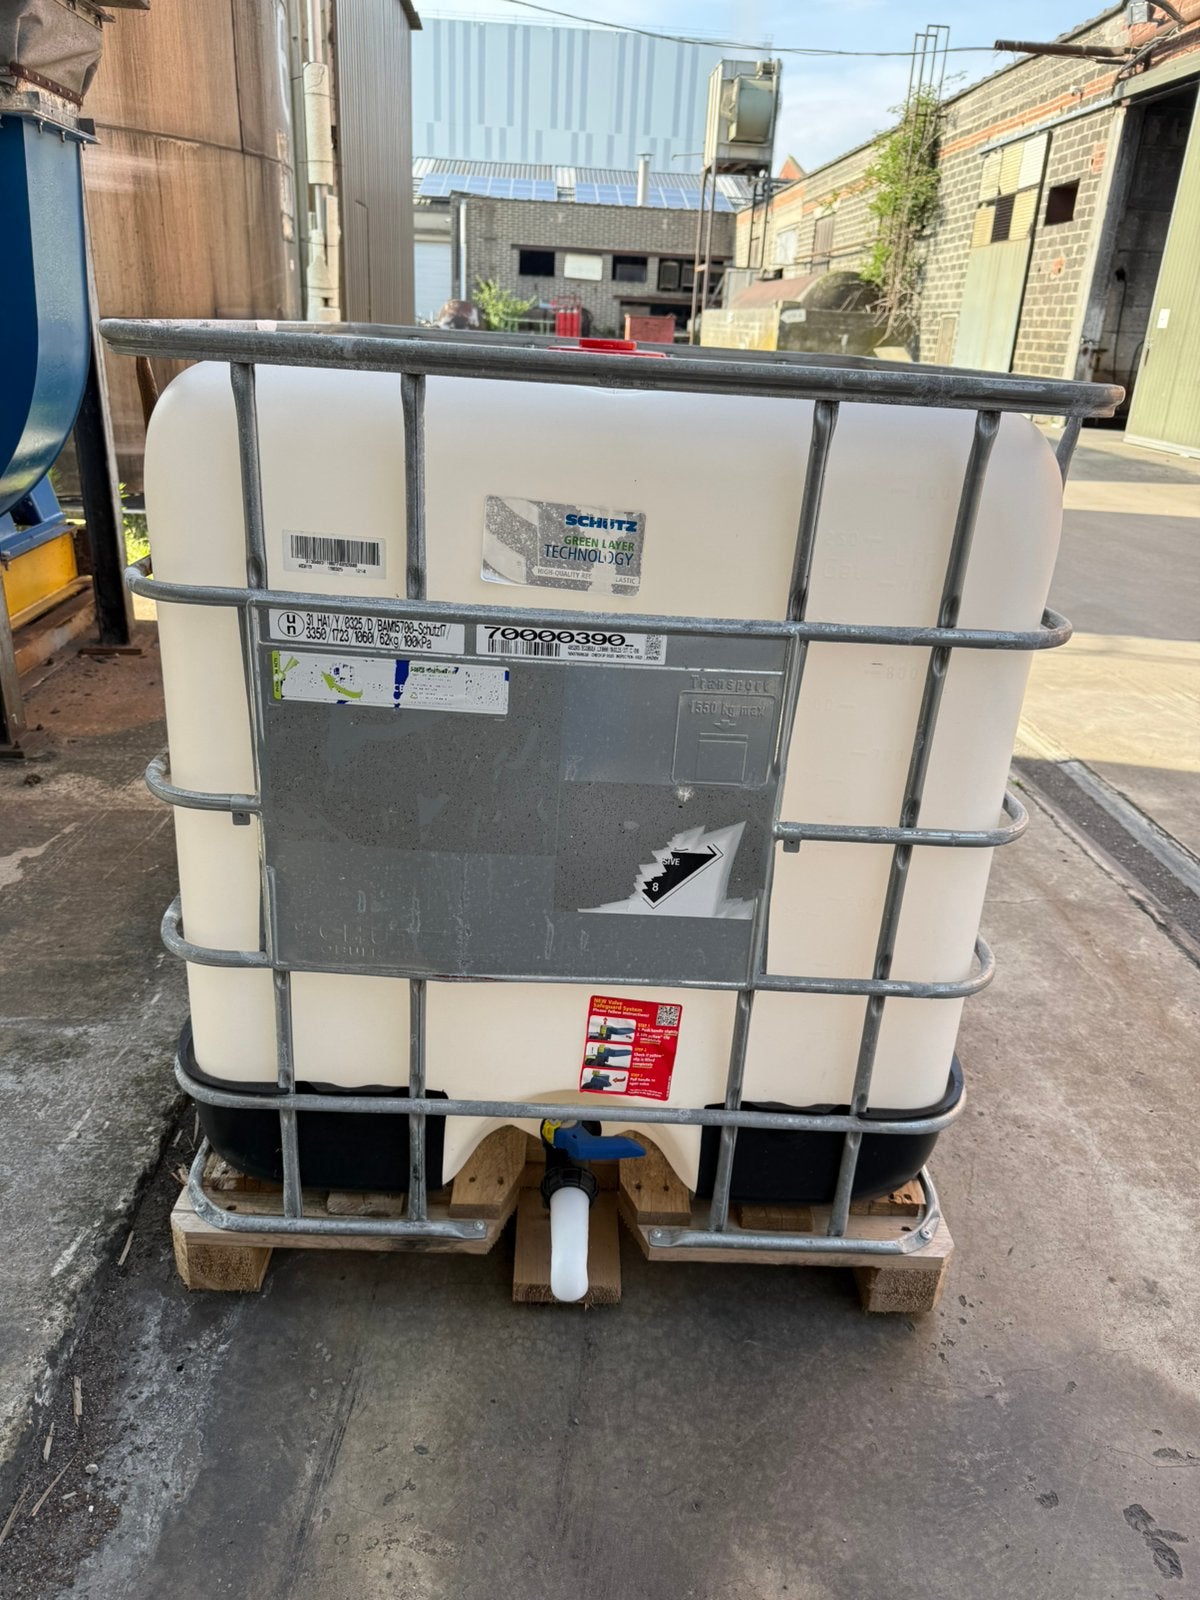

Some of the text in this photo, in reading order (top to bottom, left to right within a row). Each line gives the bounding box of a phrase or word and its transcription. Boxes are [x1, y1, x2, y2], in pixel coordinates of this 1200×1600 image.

[563, 535, 635, 552] GREEN LAYER
[544, 543, 634, 566] TECHNOLOGY
[537, 568, 580, 579] HIGH-QUALITY
[615, 576, 636, 585] LASTIC
[690, 674, 769, 693] Transport
[688, 699, 718, 716] 1550
[739, 704, 767, 719] max
[661, 857, 681, 866] SIVE
[652, 882, 659, 892] 8
[593, 1003, 622, 1011] Safeguard
